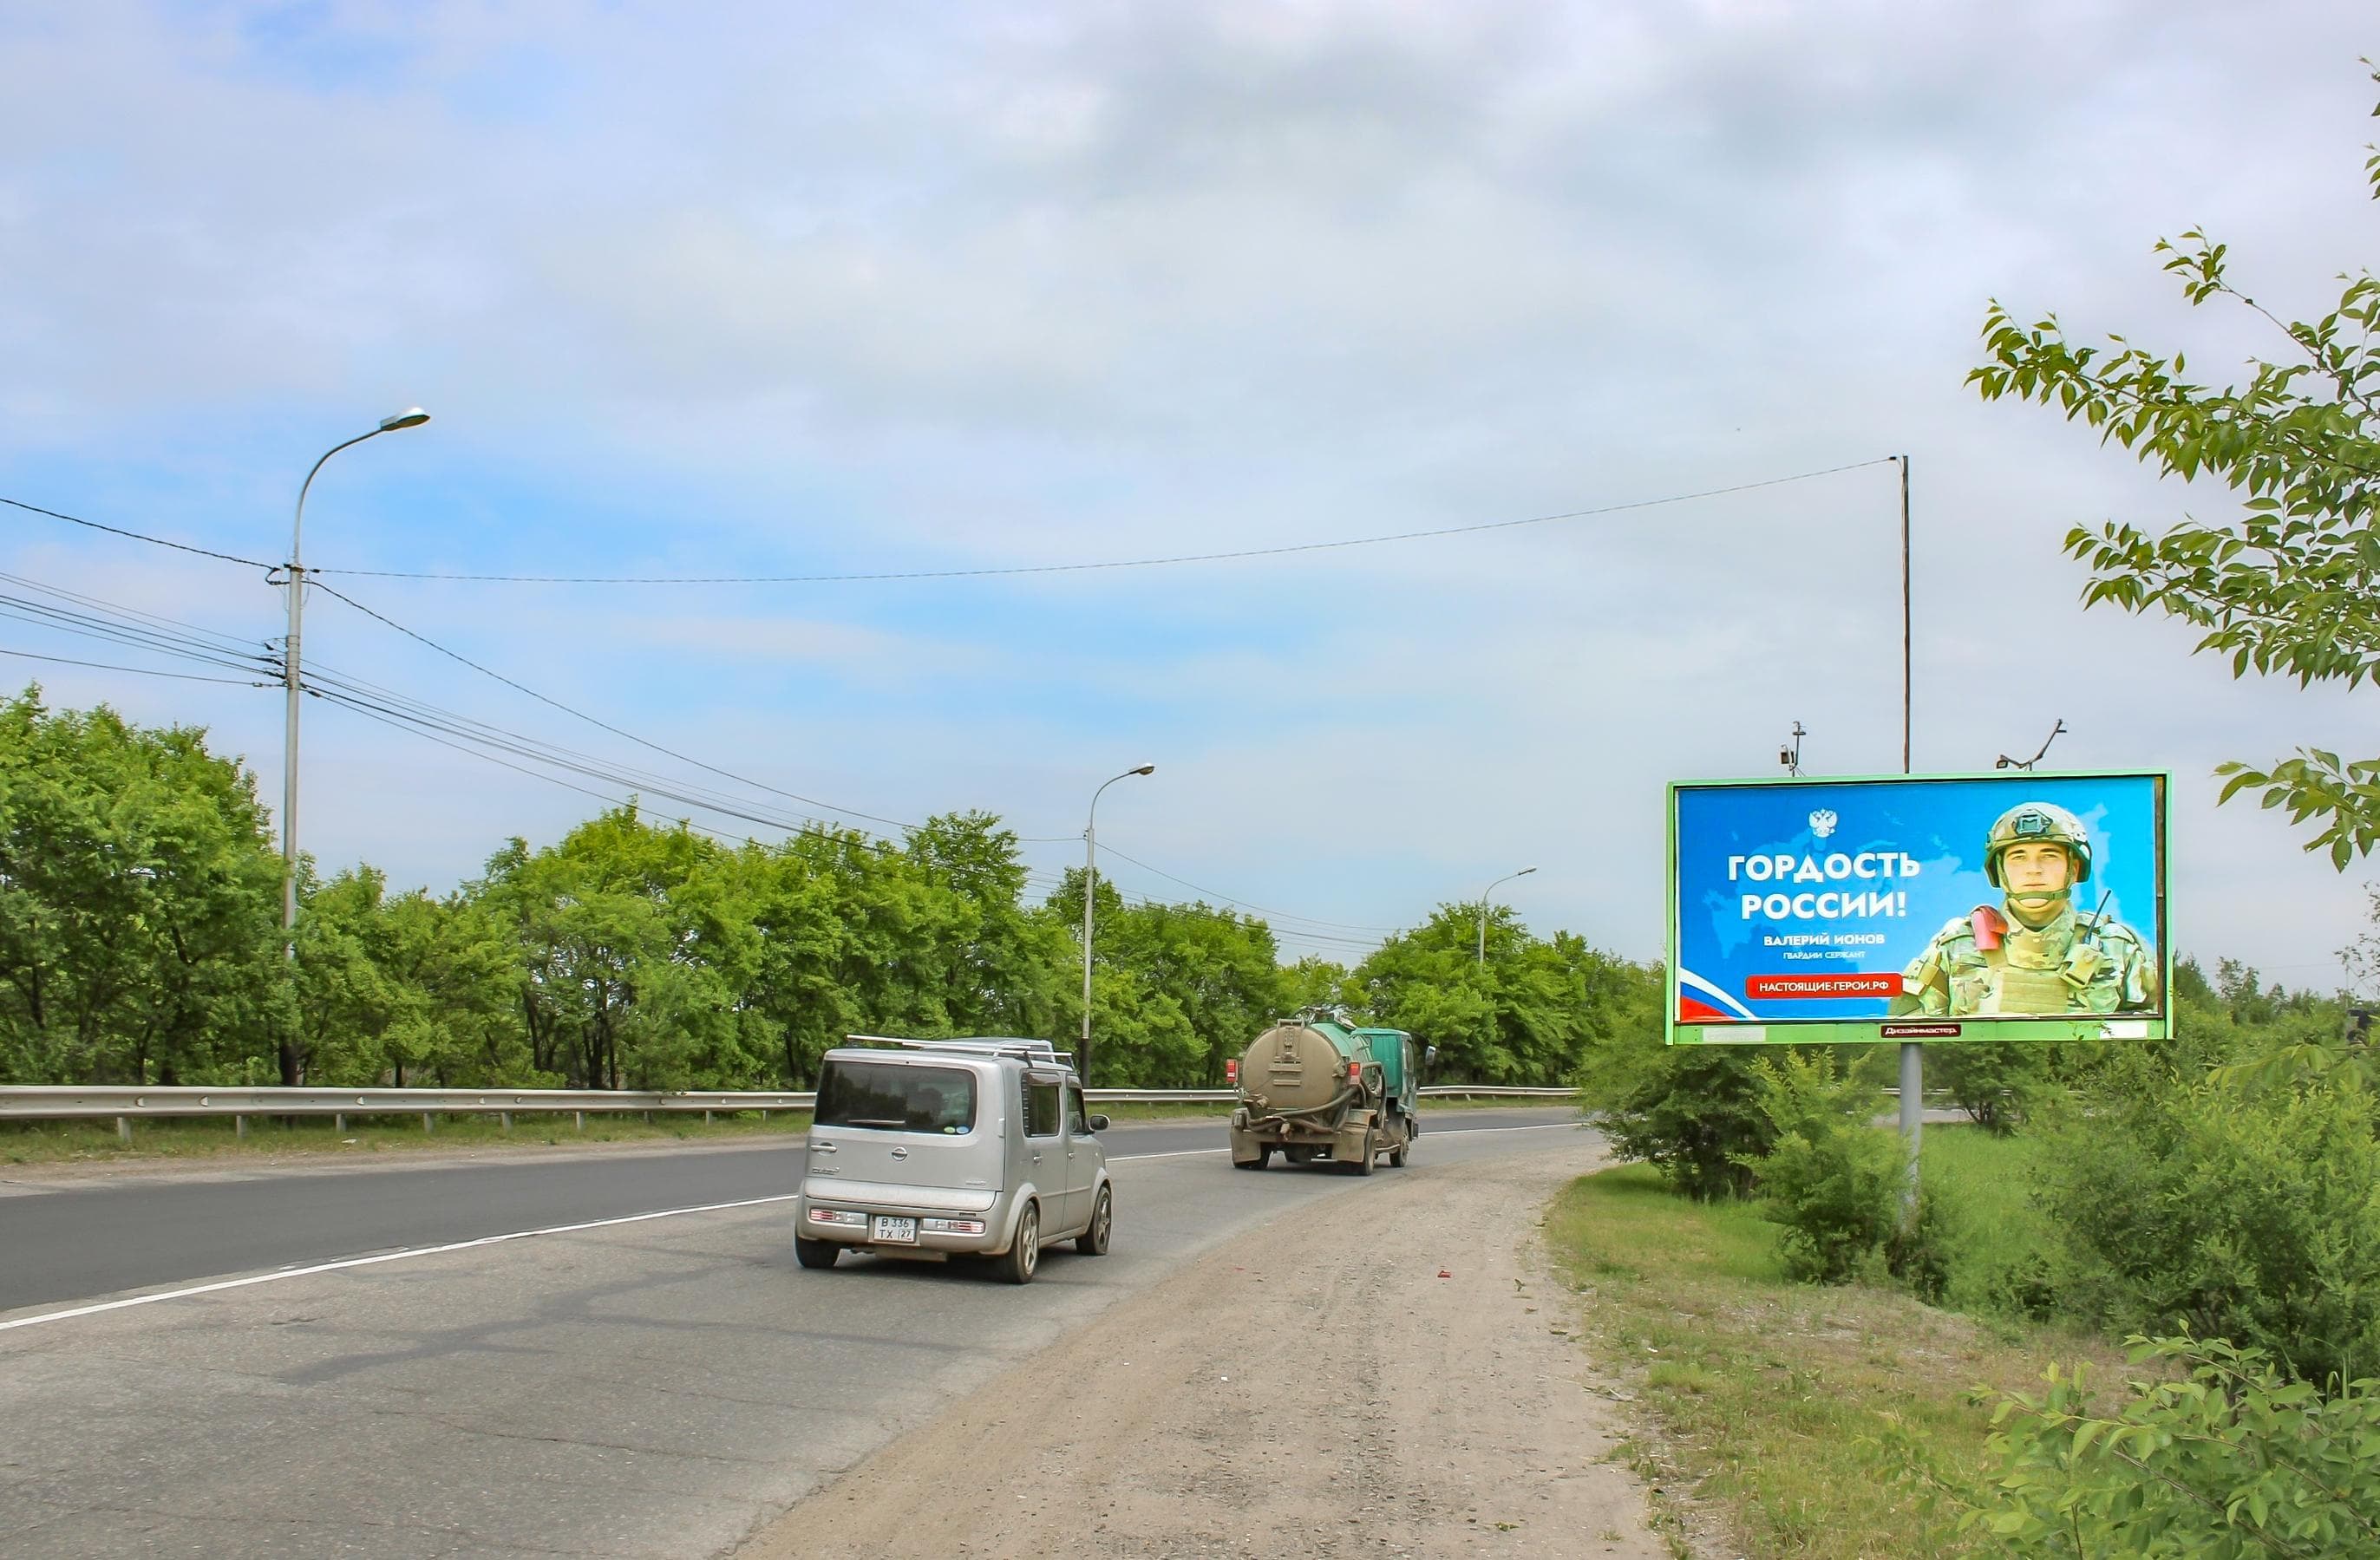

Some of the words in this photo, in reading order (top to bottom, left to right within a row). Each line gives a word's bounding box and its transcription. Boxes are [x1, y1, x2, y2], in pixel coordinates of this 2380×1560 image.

[1728, 852, 1920, 883] ГОРДОСТЬ
[1742, 891, 1906, 920] РОССИИ!
[1763, 932, 1829, 946] ВАЛЕРИЙ
[1834, 934, 1886, 945] ИОНОВ
[1783, 951, 1822, 960] ГВАРДИИ
[1824, 950, 1866, 959] СЕРЖАНТ
[1759, 981, 1889, 993] НАСТОЯЩИЕ-ГЕРОИ.РФ
[892, 1218, 909, 1228] 336
